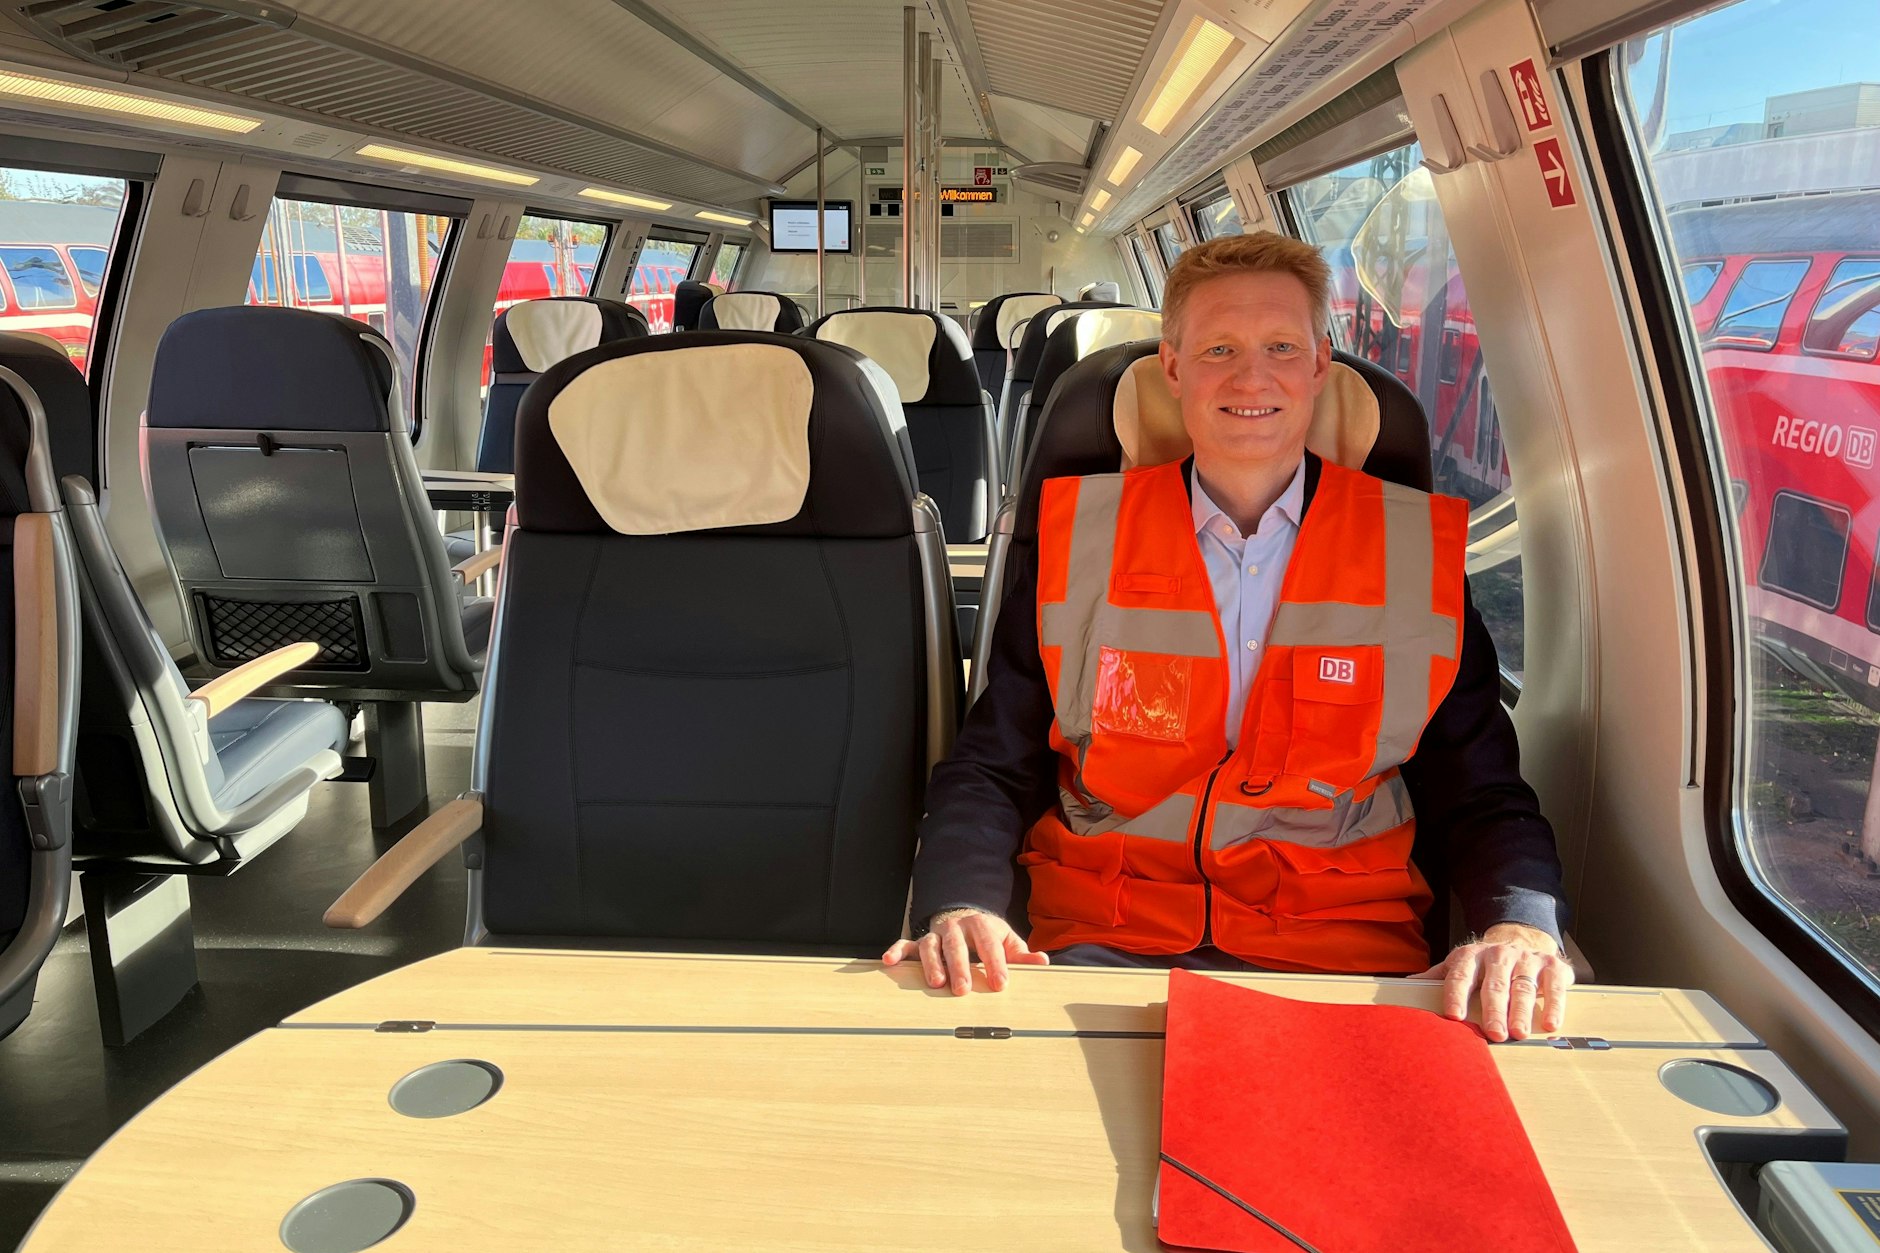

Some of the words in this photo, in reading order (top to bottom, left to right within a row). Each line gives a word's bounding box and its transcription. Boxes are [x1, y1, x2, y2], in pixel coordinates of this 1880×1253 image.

[1771, 415, 1843, 458] REGIO
[1847, 431, 1874, 463] DB
[1321, 658, 1353, 681] DB
